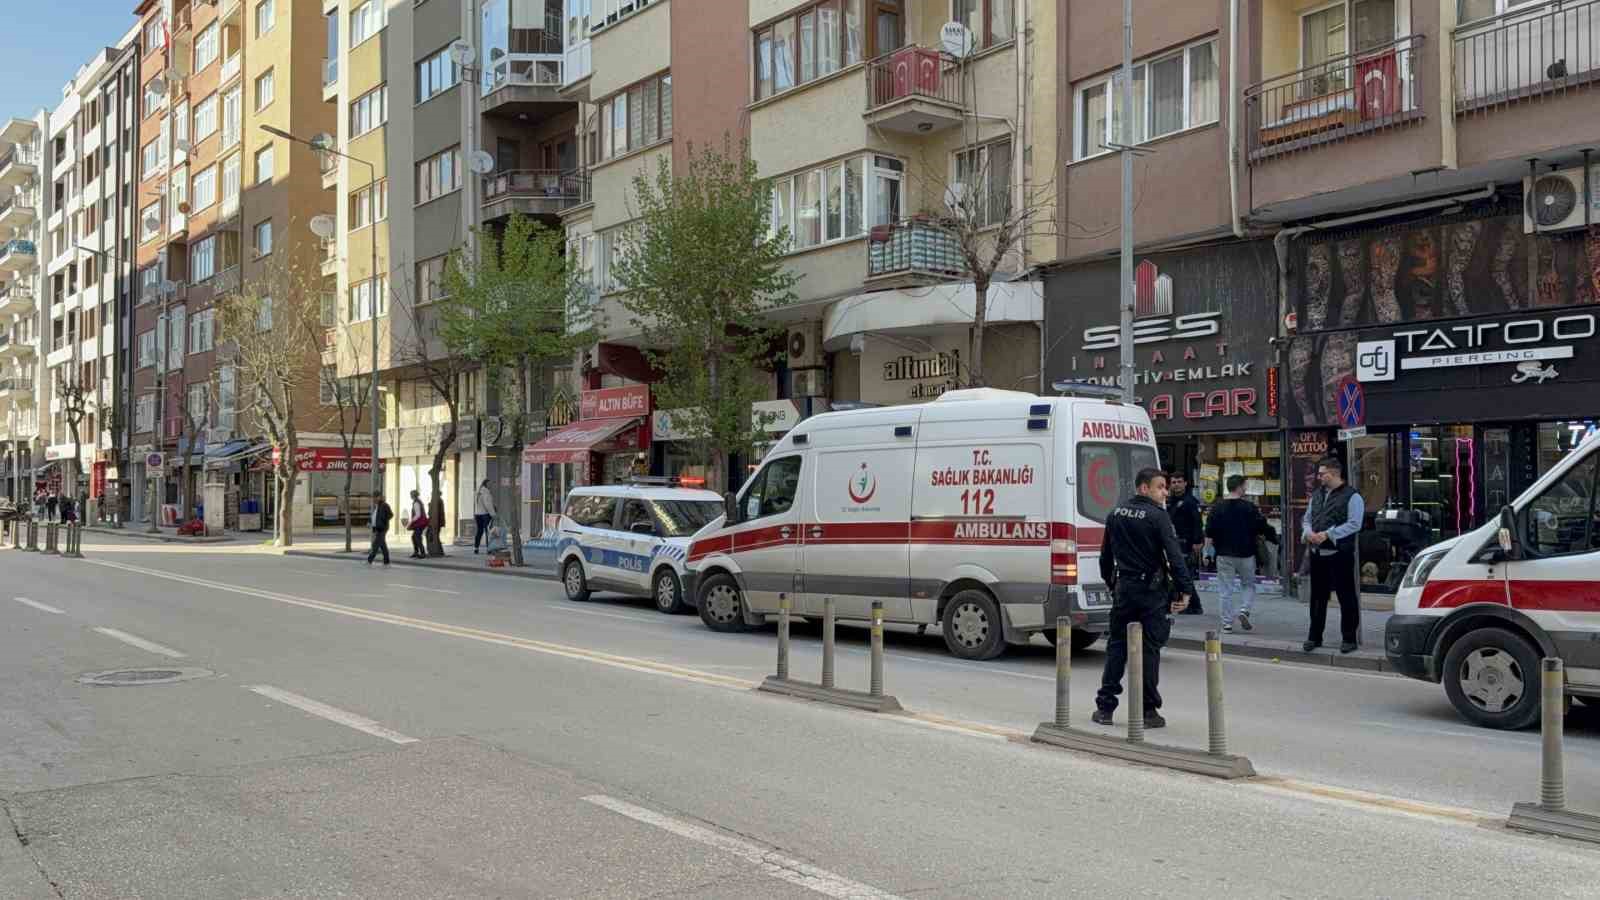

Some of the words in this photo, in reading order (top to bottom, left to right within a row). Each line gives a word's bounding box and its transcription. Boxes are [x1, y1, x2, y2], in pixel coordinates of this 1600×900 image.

[1082, 312, 1222, 350] SES
[1072, 343, 1228, 371] İNAAT
[1431, 350, 1535, 367] PIERCING
[1174, 362, 1252, 382] EMLAK
[1183, 387, 1257, 419] CAR
[1082, 421, 1150, 442] AMBULANS
[972, 450, 992, 465] T.C.
[931, 467, 970, 486] SAĞLIK
[972, 464, 1034, 485] BAKANLIĞI
[960, 489, 994, 514] 112
[954, 522, 1048, 538] AMBULANS
[618, 556, 642, 571] POLİS
